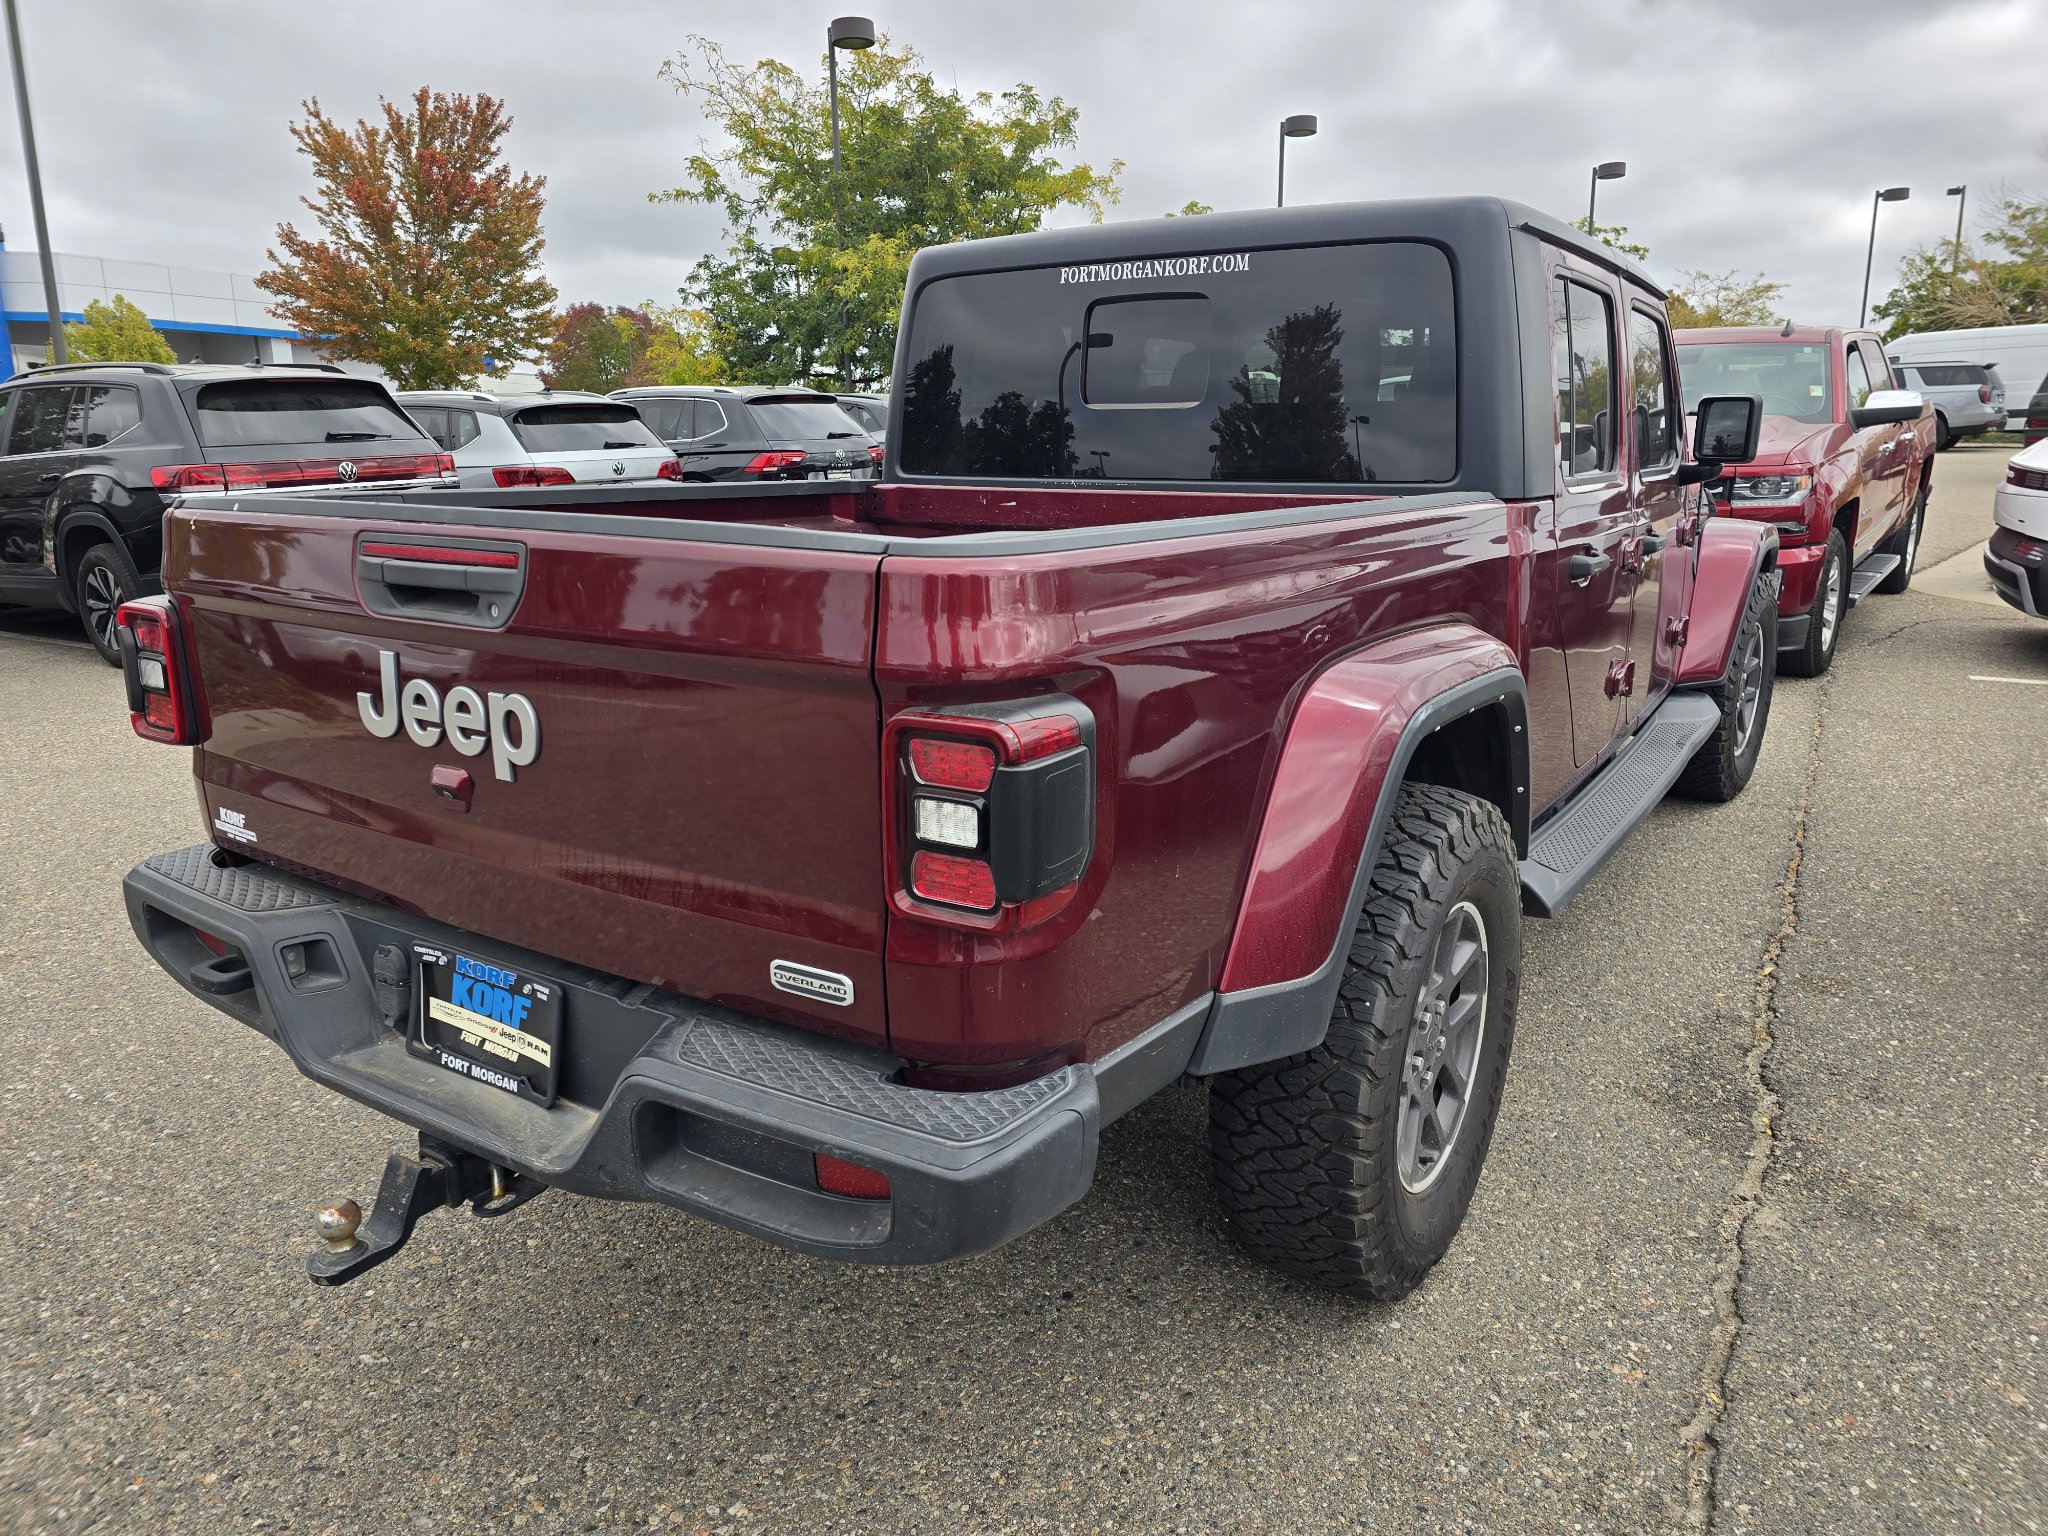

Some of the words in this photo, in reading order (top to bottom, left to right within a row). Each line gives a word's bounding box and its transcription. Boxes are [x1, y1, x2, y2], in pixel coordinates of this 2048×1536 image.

[1060, 253, 1250, 284] FORTMORGANKORF.COM
[356, 650, 541, 783] Jeep
[219, 806, 246, 828] KORF
[456, 955, 517, 990] KORF
[774, 972, 847, 996] OVERLAND
[452, 973, 532, 1029] KORF
[460, 1030, 483, 1047] FORT
[482, 1040, 519, 1063] MORGAN
[499, 1027, 517, 1044] Jeep
[527, 1041, 548, 1057] RAM
[441, 1053, 469, 1075] FORT
[471, 1065, 518, 1093] MORGAN
